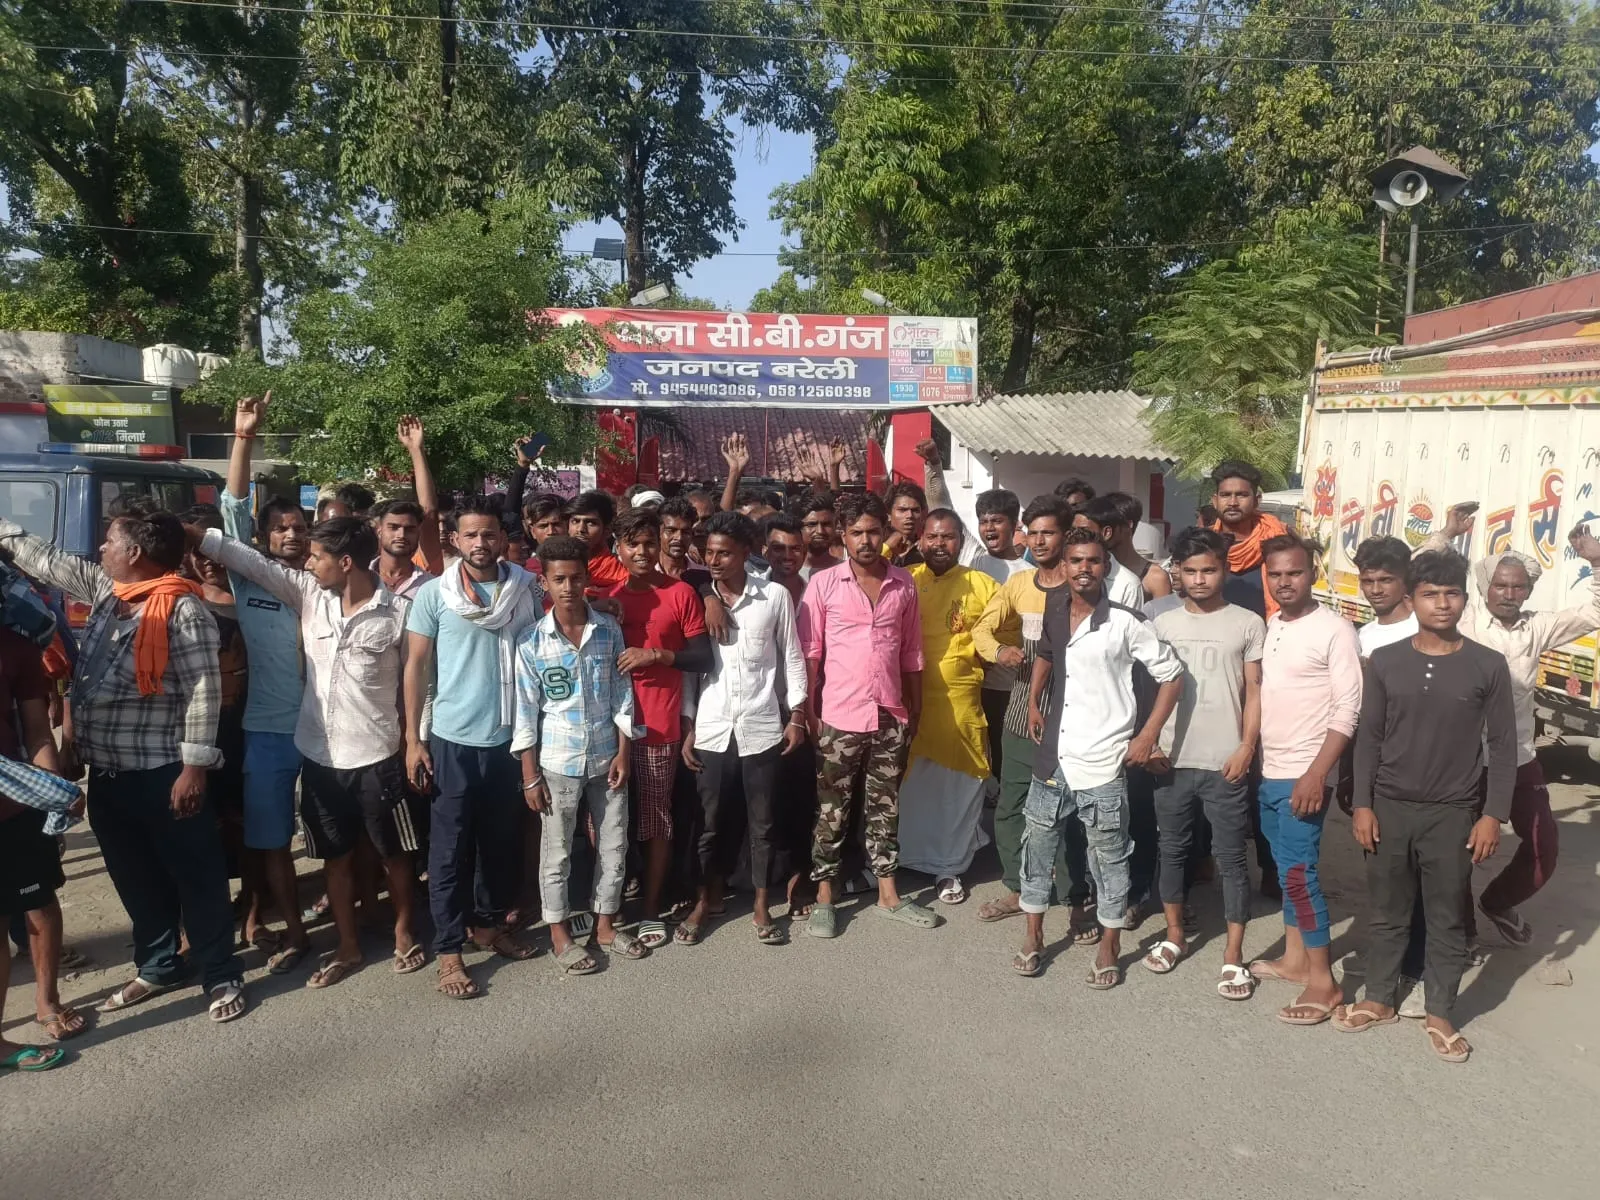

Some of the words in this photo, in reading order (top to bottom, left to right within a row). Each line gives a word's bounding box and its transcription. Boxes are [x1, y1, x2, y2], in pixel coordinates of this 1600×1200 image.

[706, 313, 885, 350] सी.बी.गंज
[644, 359, 762, 378] जनपद
[770, 357, 858, 380] बरेली
[631, 379, 653, 395] मो.
[768, 384, 872, 398] 05812560398
[921, 387, 940, 397] 1076
[93, 417, 110, 428] फोन
[115, 430, 146, 443] मिलाएं
[543, 666, 571, 700] S
